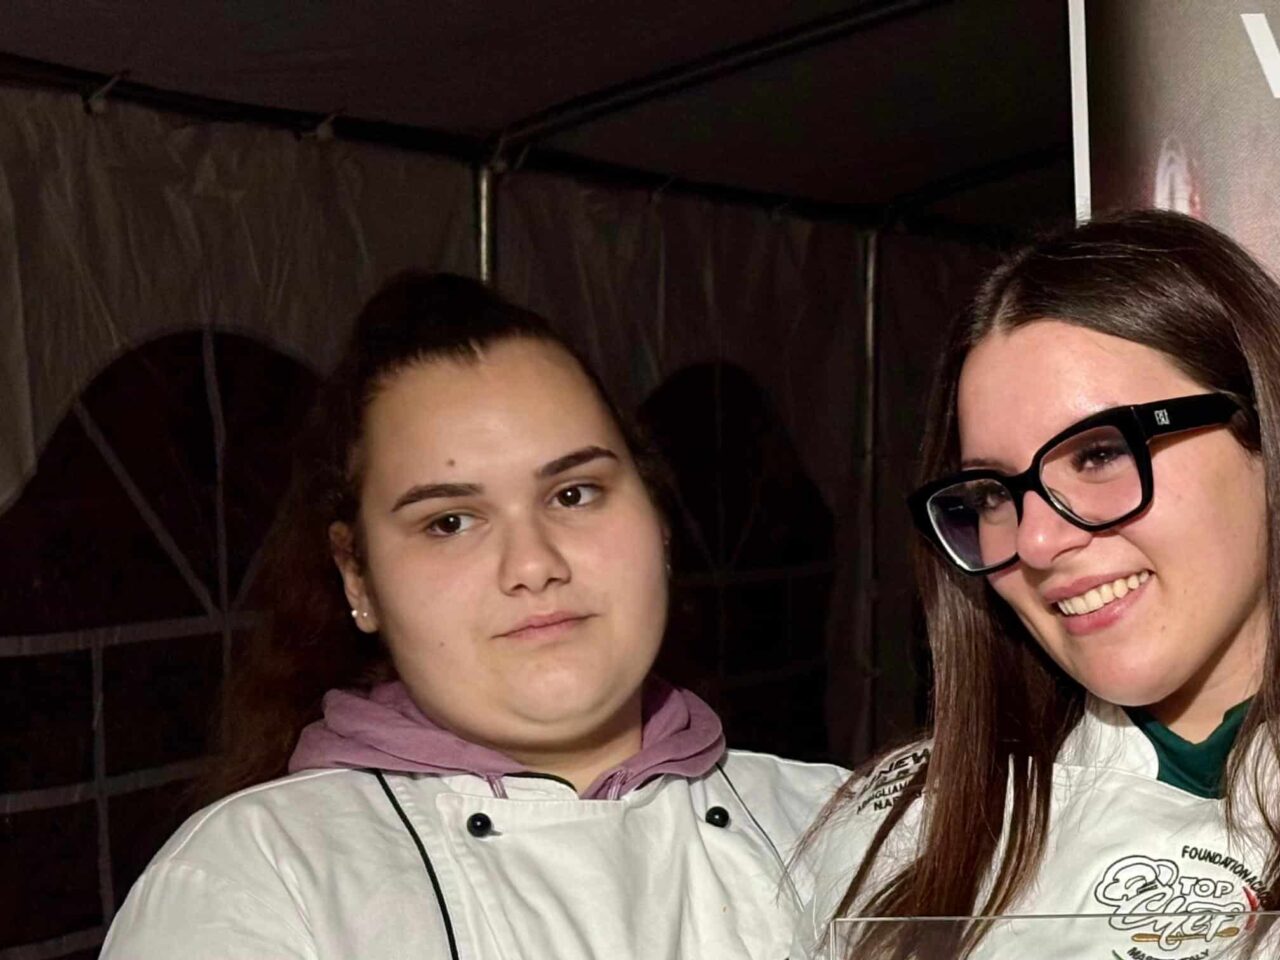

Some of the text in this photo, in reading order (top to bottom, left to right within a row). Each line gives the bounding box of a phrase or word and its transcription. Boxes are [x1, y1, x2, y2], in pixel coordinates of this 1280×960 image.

[1181, 845, 1252, 880] FOUNDATION
[1179, 876, 1234, 898] TOP
[1109, 890, 1246, 951] Chef
